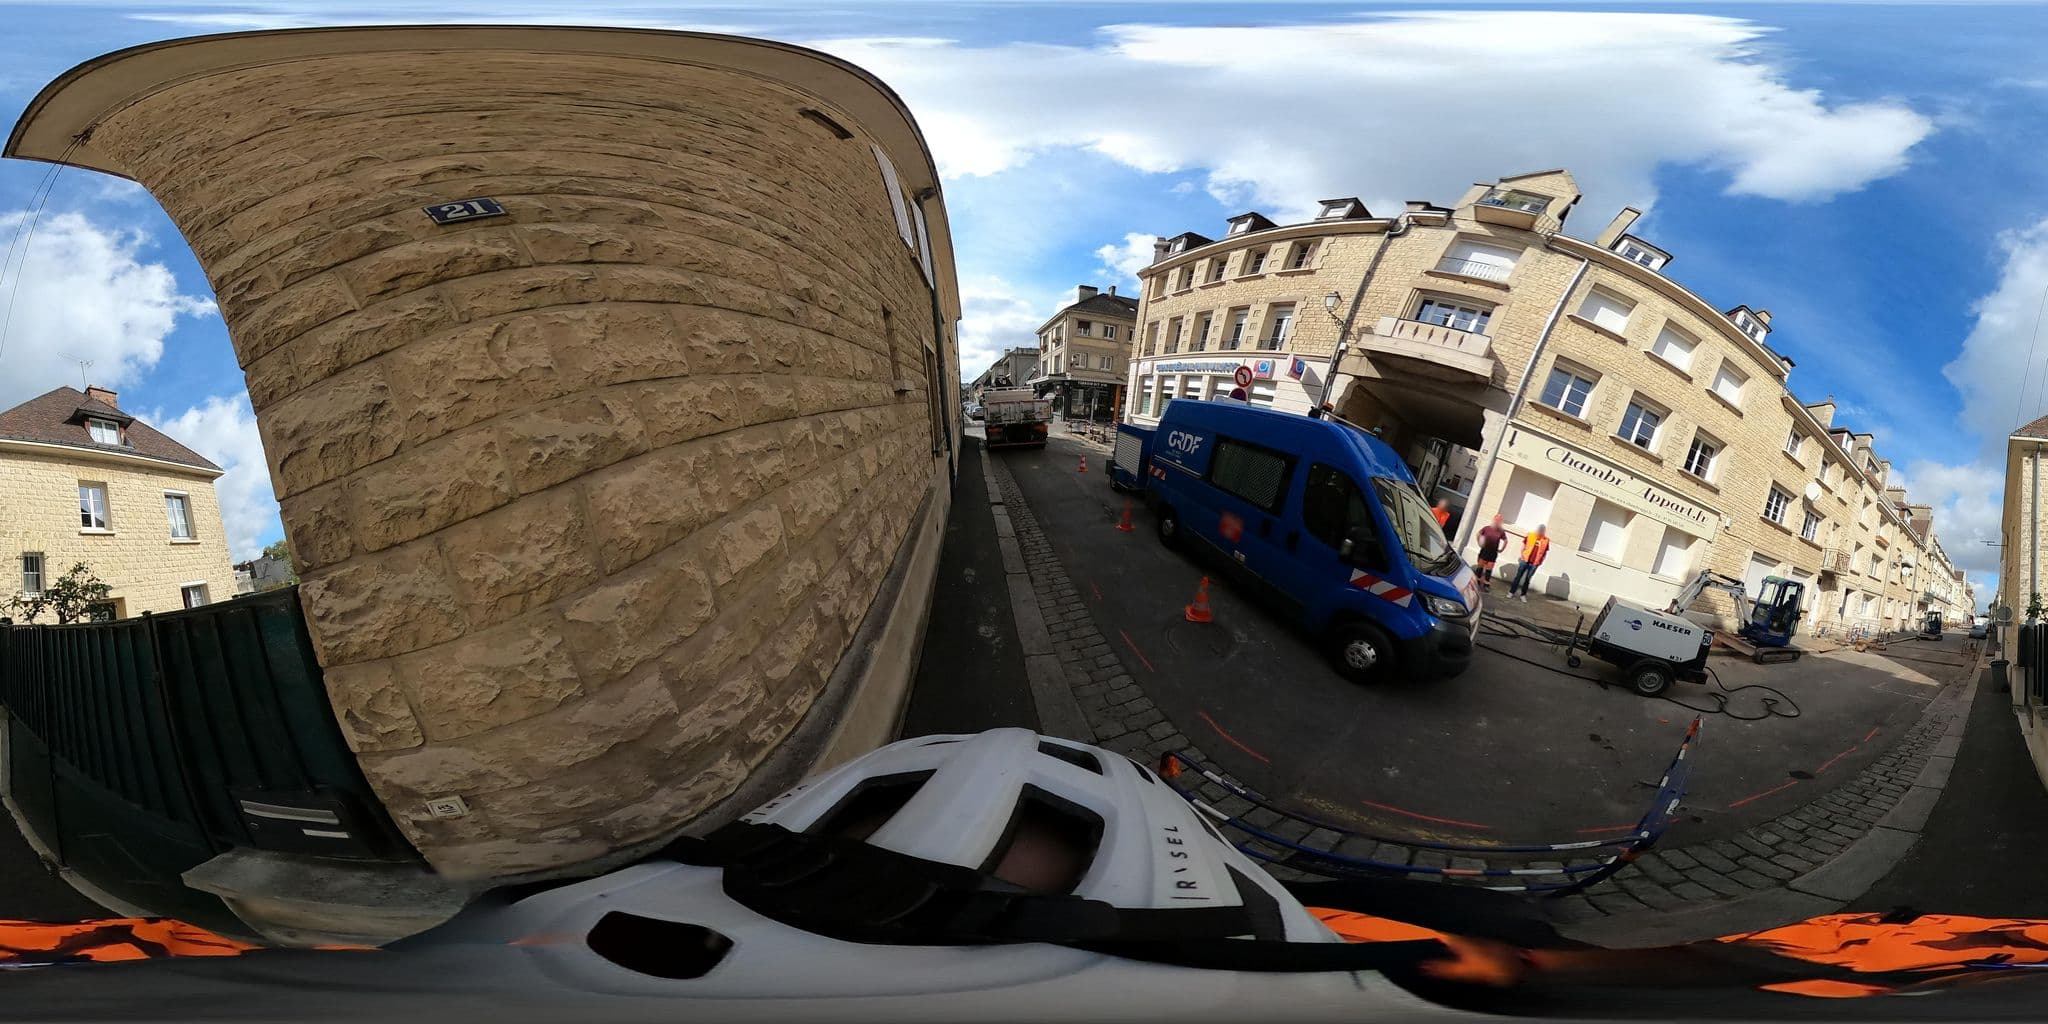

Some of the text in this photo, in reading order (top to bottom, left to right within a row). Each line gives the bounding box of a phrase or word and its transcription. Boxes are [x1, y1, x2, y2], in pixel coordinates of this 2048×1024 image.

[441, 201, 488, 218] 21
[1168, 430, 1203, 454] GRDF
[1652, 620, 1691, 635] KAESER
